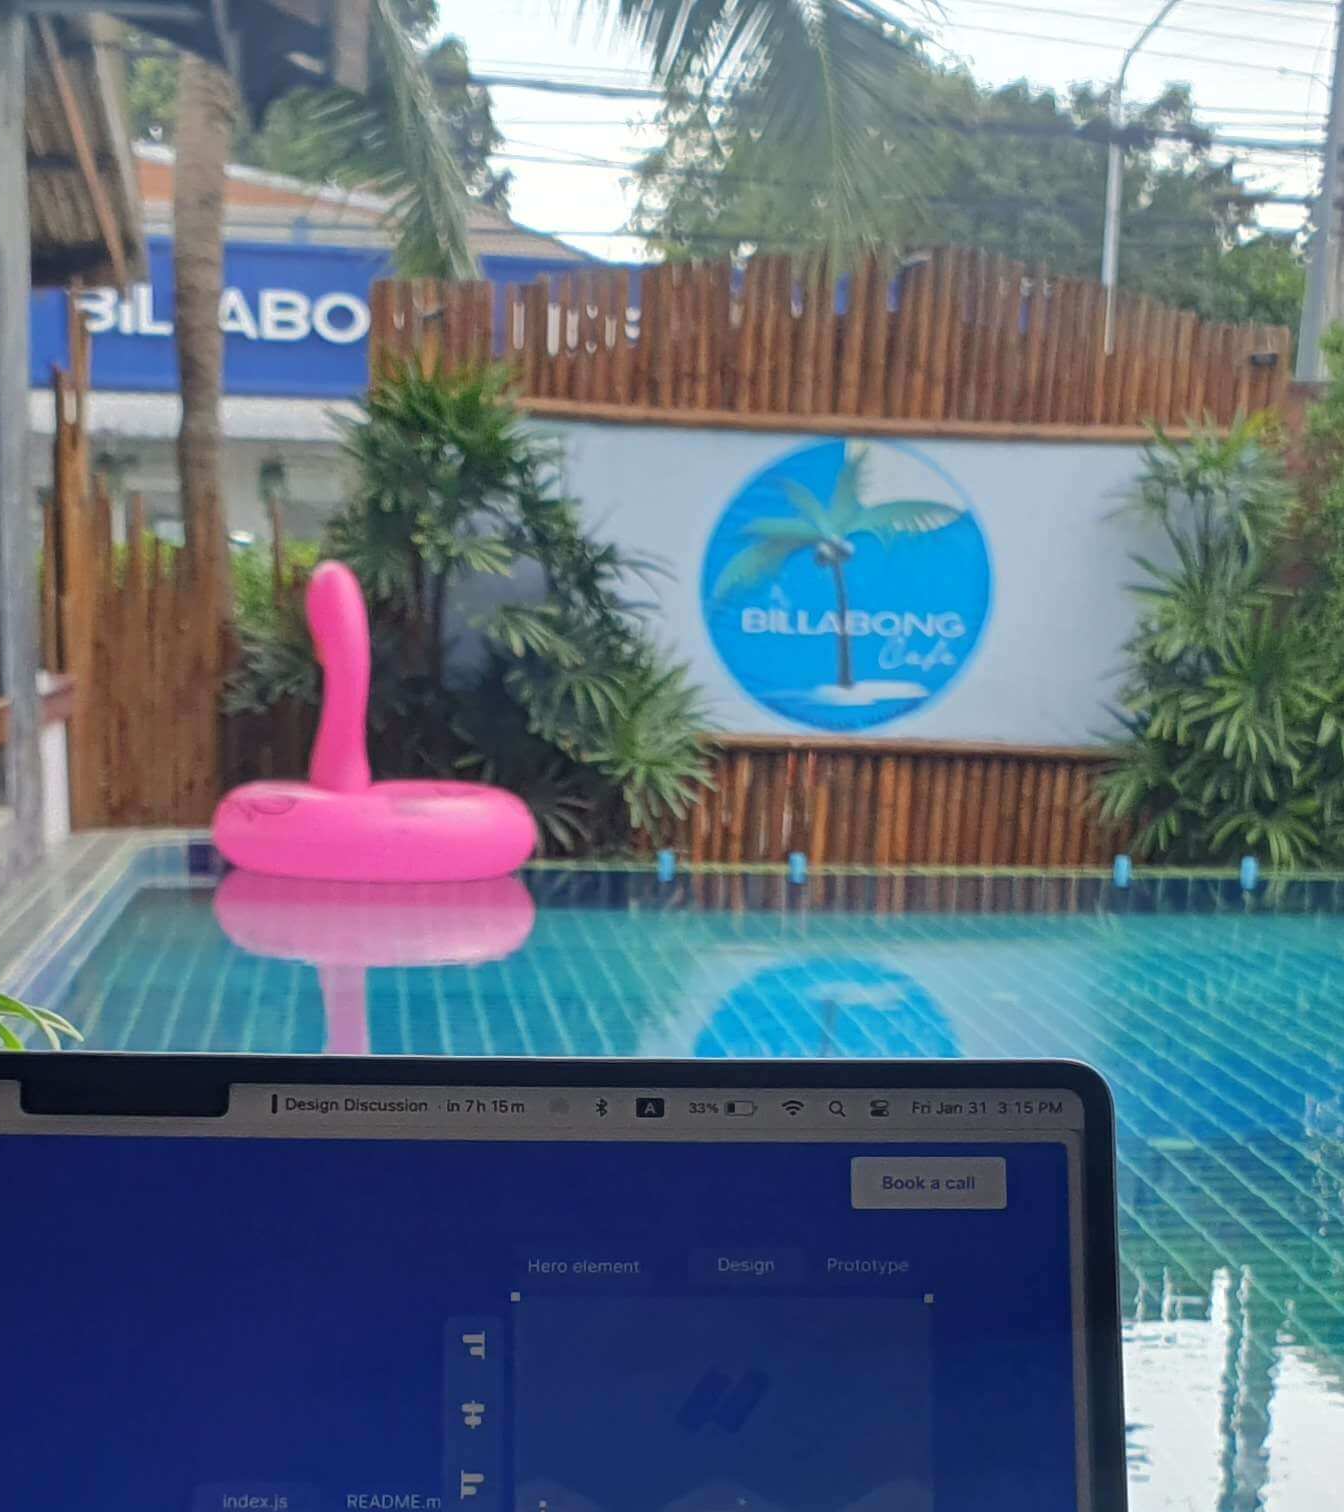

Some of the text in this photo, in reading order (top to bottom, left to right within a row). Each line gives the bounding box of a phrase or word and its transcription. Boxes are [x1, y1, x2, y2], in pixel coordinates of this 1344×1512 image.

[285, 1097, 340, 1114] Design
[344, 1097, 428, 1113] Discussion
[446, 1098, 461, 1113] in
[911, 1101, 931, 1115] Fri
[935, 1101, 964, 1115] Jan
[968, 1101, 987, 1115] 31
[1037, 1101, 1064, 1115] PM
[882, 1175, 976, 1191] Book a call
[528, 1258, 640, 1274] Hero element
[717, 1257, 775, 1275] Design
[826, 1257, 909, 1275] Prototype
[223, 1494, 288, 1512] index.js
